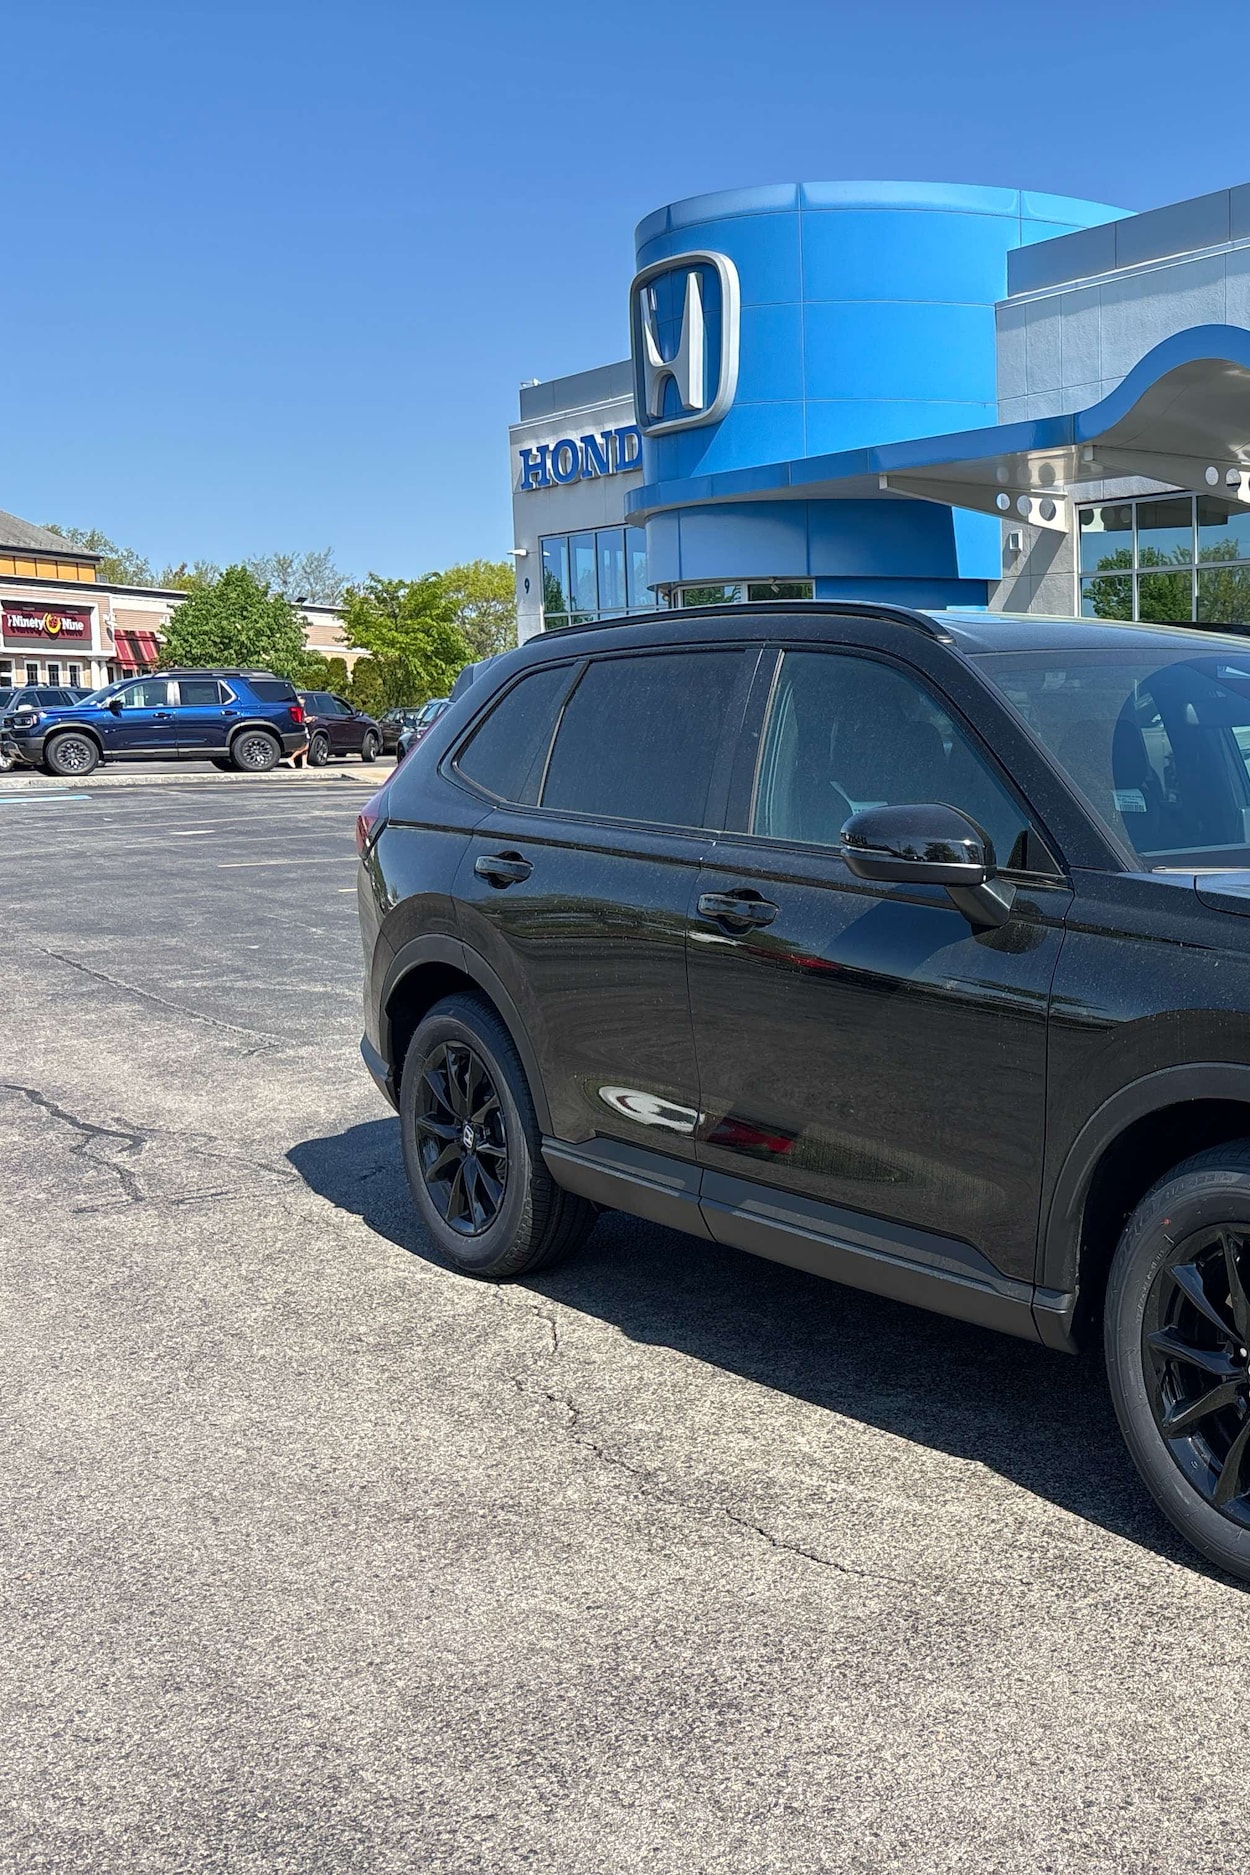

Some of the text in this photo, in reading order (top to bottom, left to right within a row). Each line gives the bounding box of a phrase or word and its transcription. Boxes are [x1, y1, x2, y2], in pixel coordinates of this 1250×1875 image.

[524, 577, 530, 594] 9
[12, 614, 44, 631] Ninety
[62, 617, 85, 631] Nine
